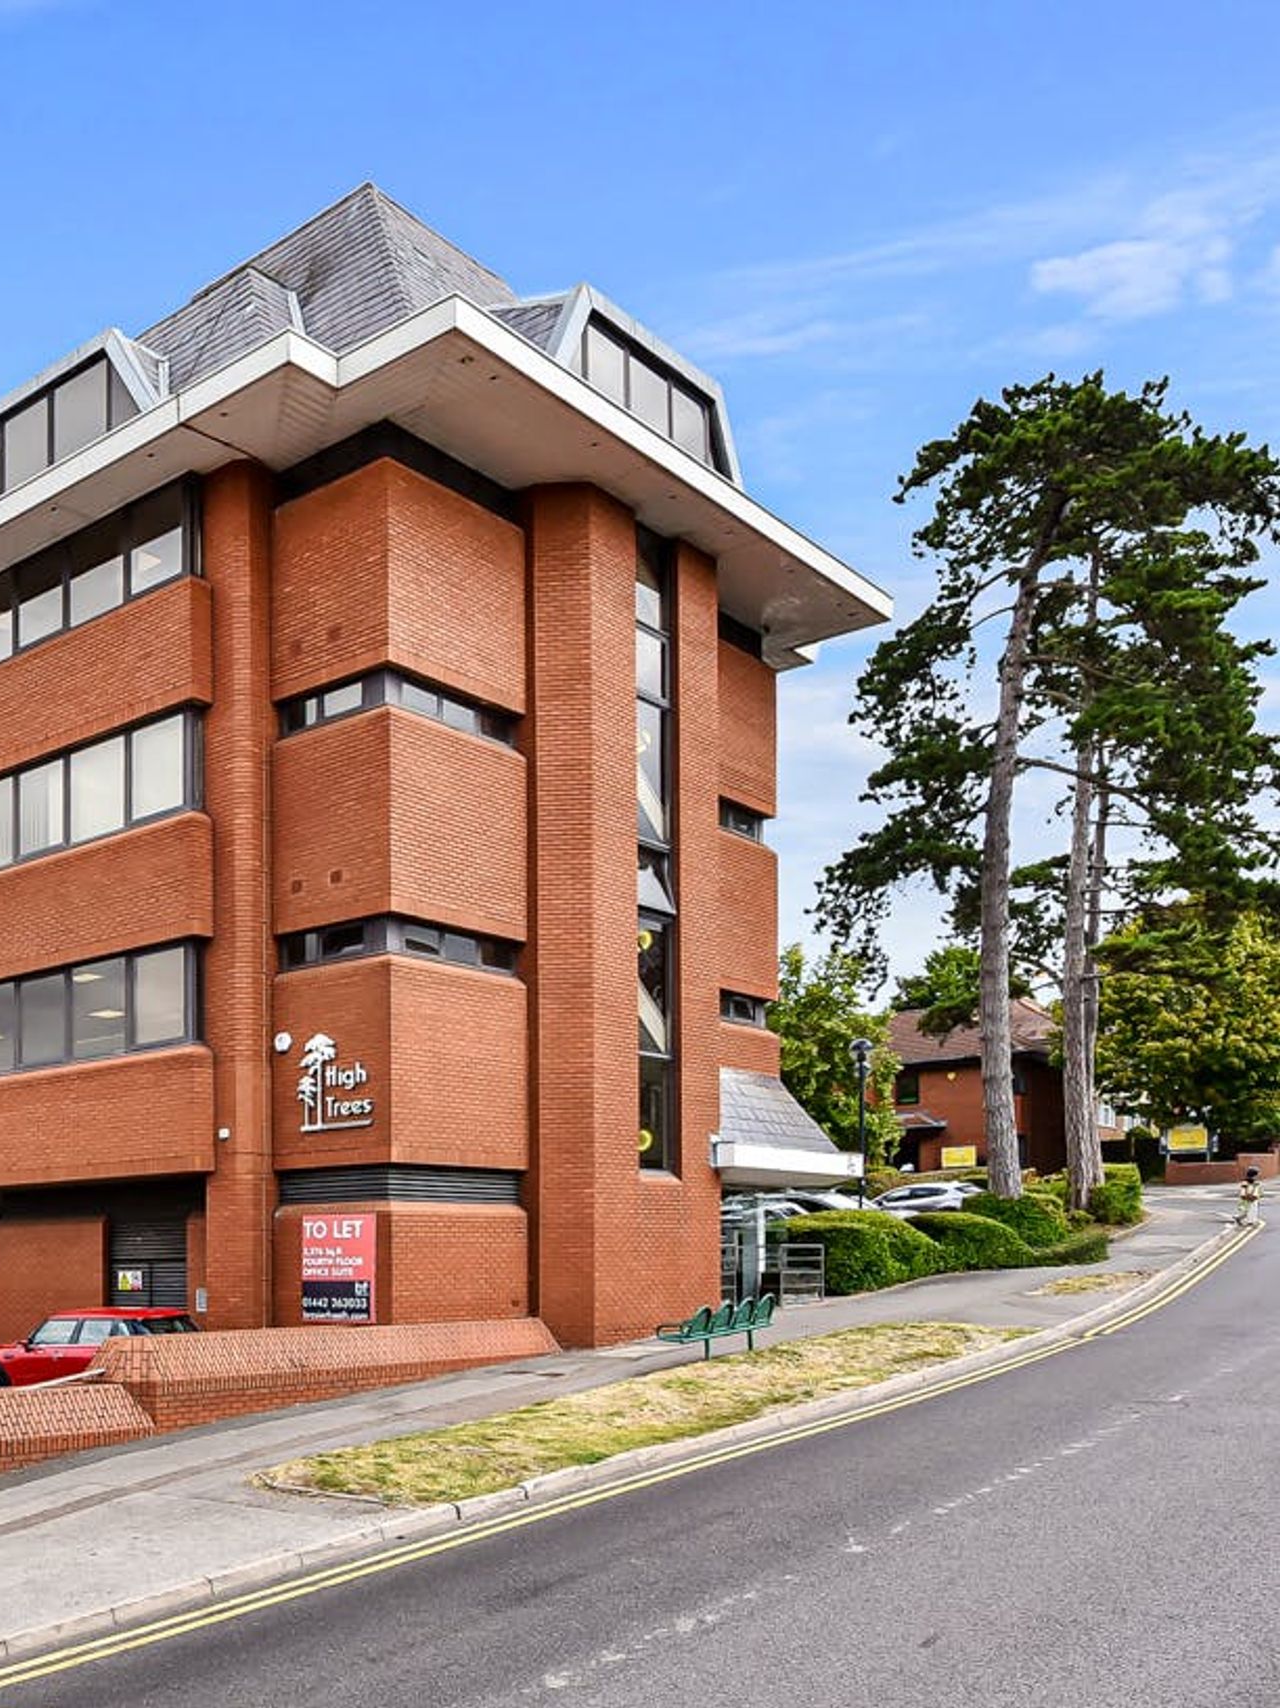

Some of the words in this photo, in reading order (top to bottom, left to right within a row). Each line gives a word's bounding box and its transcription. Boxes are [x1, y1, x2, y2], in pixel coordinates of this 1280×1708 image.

[325, 1060, 367, 1090] High
[325, 1096, 373, 1117] Trees
[303, 1220, 327, 1239] TO
[333, 1220, 363, 1239] LET
[303, 1257, 332, 1266] FOURTH
[336, 1256, 363, 1266] FLOOR
[303, 1267, 329, 1276] OFFICE
[332, 1267, 353, 1276] SUITE
